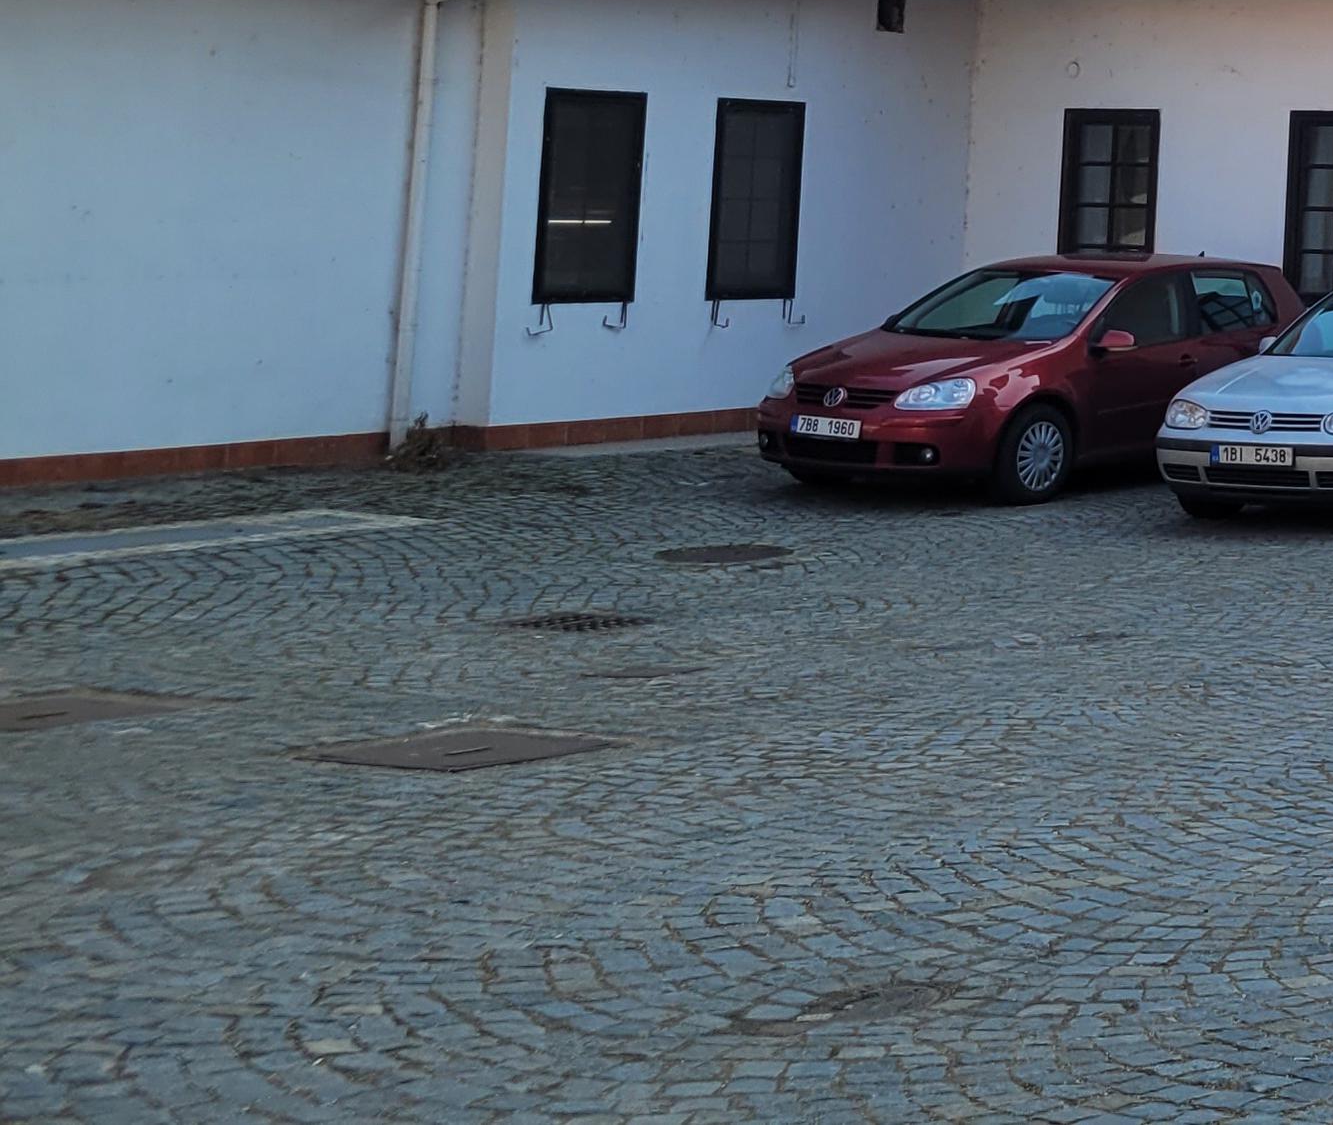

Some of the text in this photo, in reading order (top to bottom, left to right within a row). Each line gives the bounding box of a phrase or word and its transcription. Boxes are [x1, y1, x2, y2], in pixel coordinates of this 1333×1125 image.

[799, 417, 819, 432] 7B8
[827, 420, 855, 436] 1960
[1254, 448, 1287, 463] 5438
